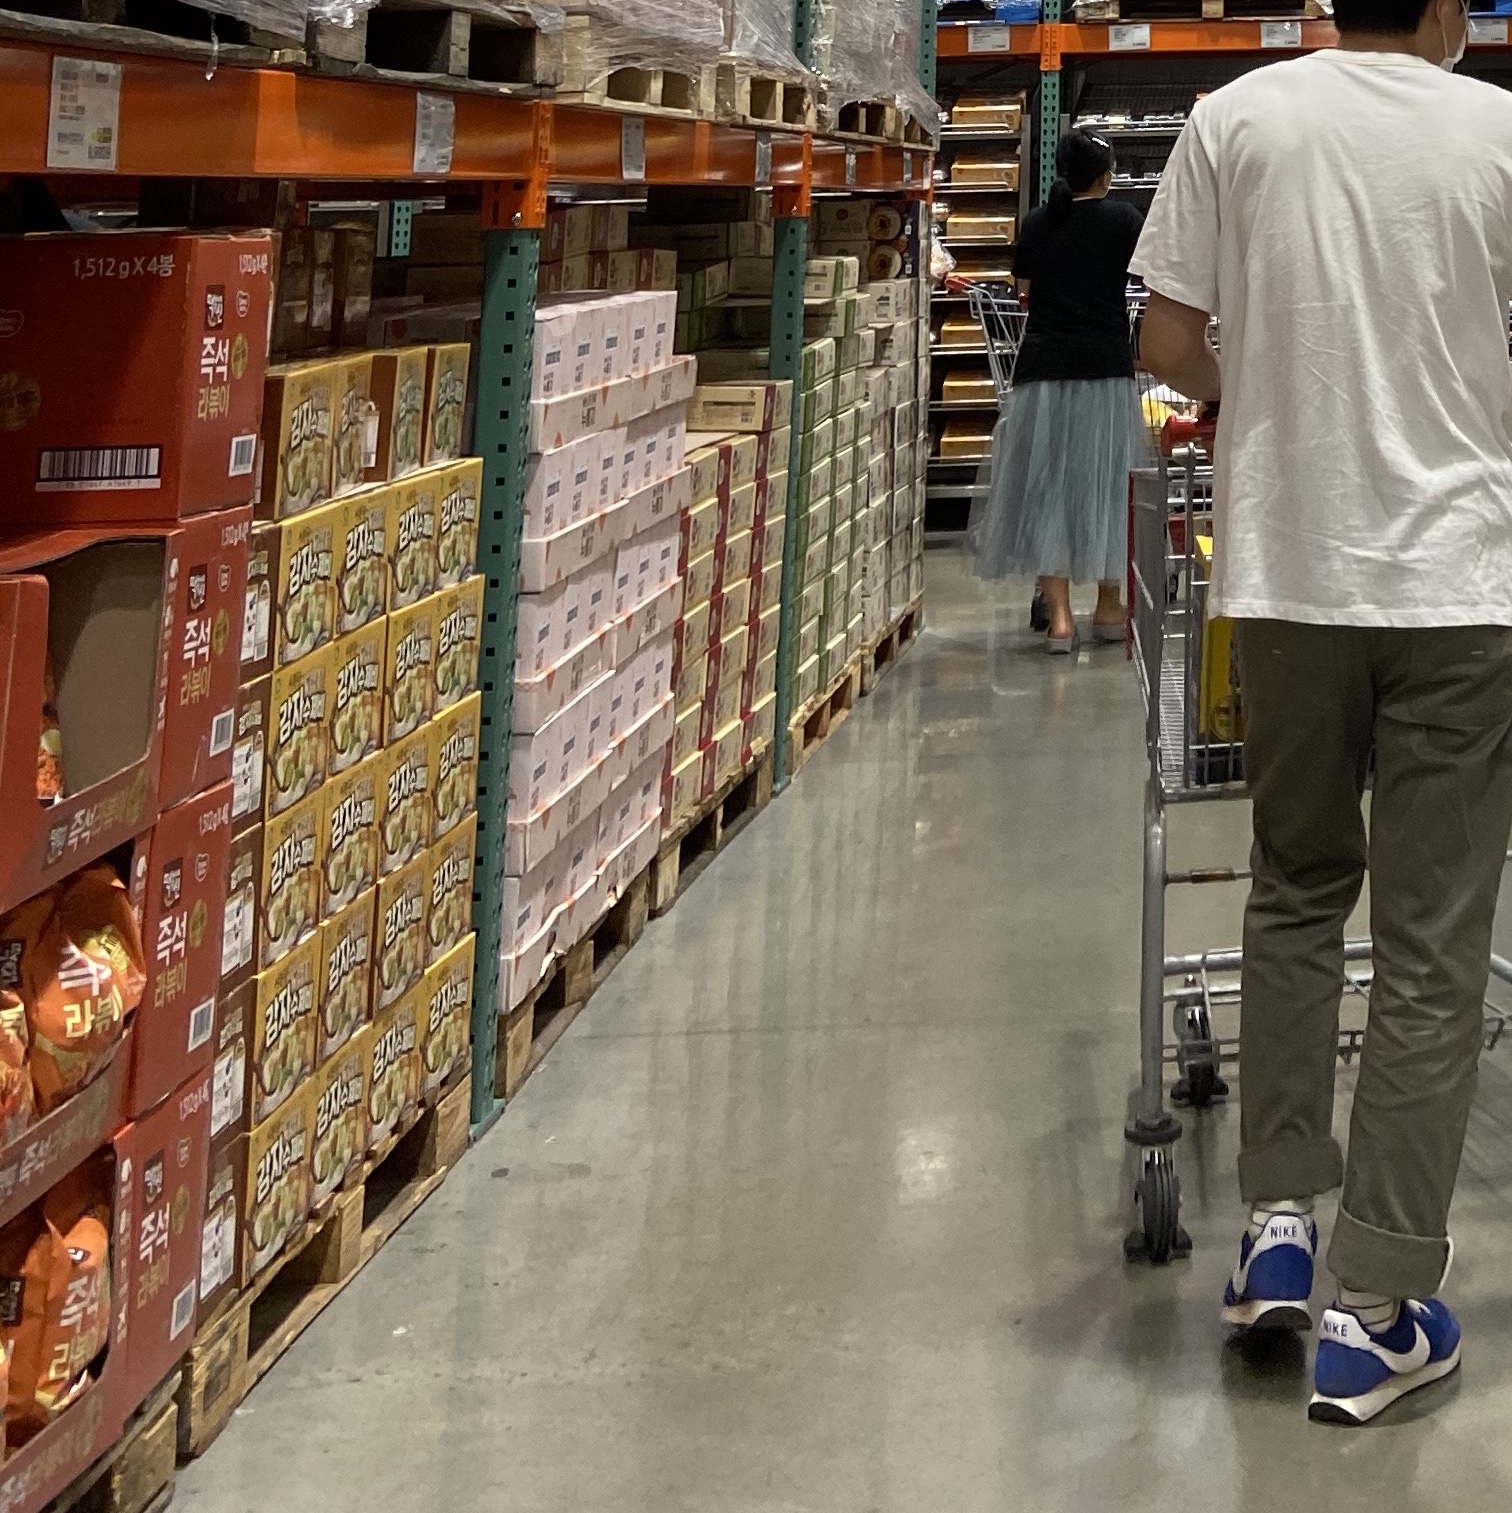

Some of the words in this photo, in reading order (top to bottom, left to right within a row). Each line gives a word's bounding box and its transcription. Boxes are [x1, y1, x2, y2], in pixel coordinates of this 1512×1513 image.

[201, 336, 230, 384] 즉석
[183, 617, 212, 668] 즉석
[157, 911, 188, 966] 즉석
[139, 1202, 170, 1264] 즉석
[1270, 1224, 1298, 1240] NIKE
[1323, 1321, 1348, 1338] NIKE
